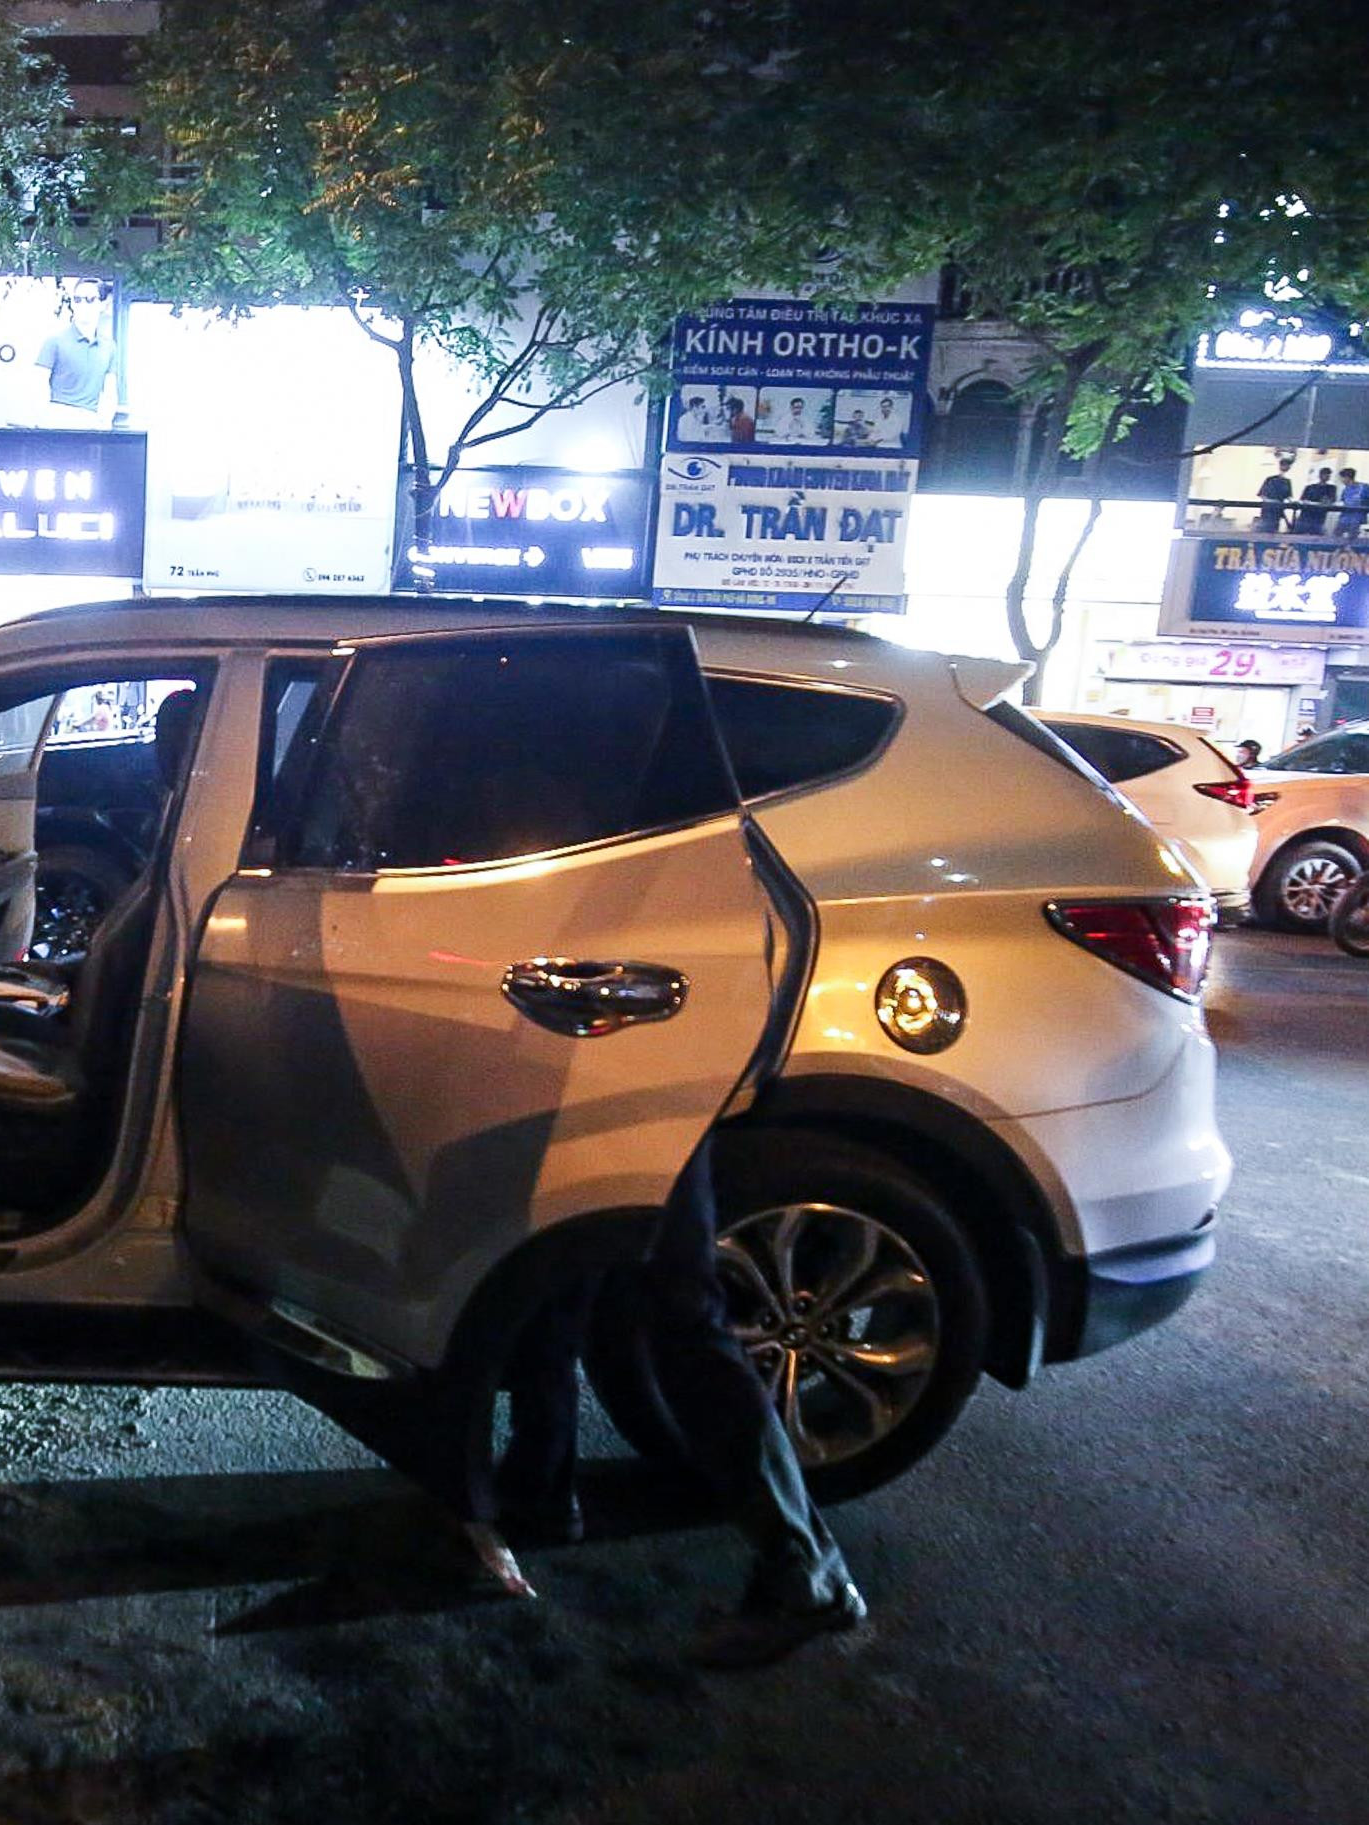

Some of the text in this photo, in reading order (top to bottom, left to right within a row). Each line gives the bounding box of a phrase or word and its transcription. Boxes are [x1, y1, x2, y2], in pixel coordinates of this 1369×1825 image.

[688, 304, 734, 319] UNG
[684, 323, 921, 360] KÍNH ORTHO-K
[439, 487, 608, 522] NEWBOX
[672, 491, 902, 553] DR. TRẦN ĐẠT
[169, 566, 185, 577] 72
[1215, 541, 1255, 571] TRÀ
[1263, 543, 1301, 572] SỮA
